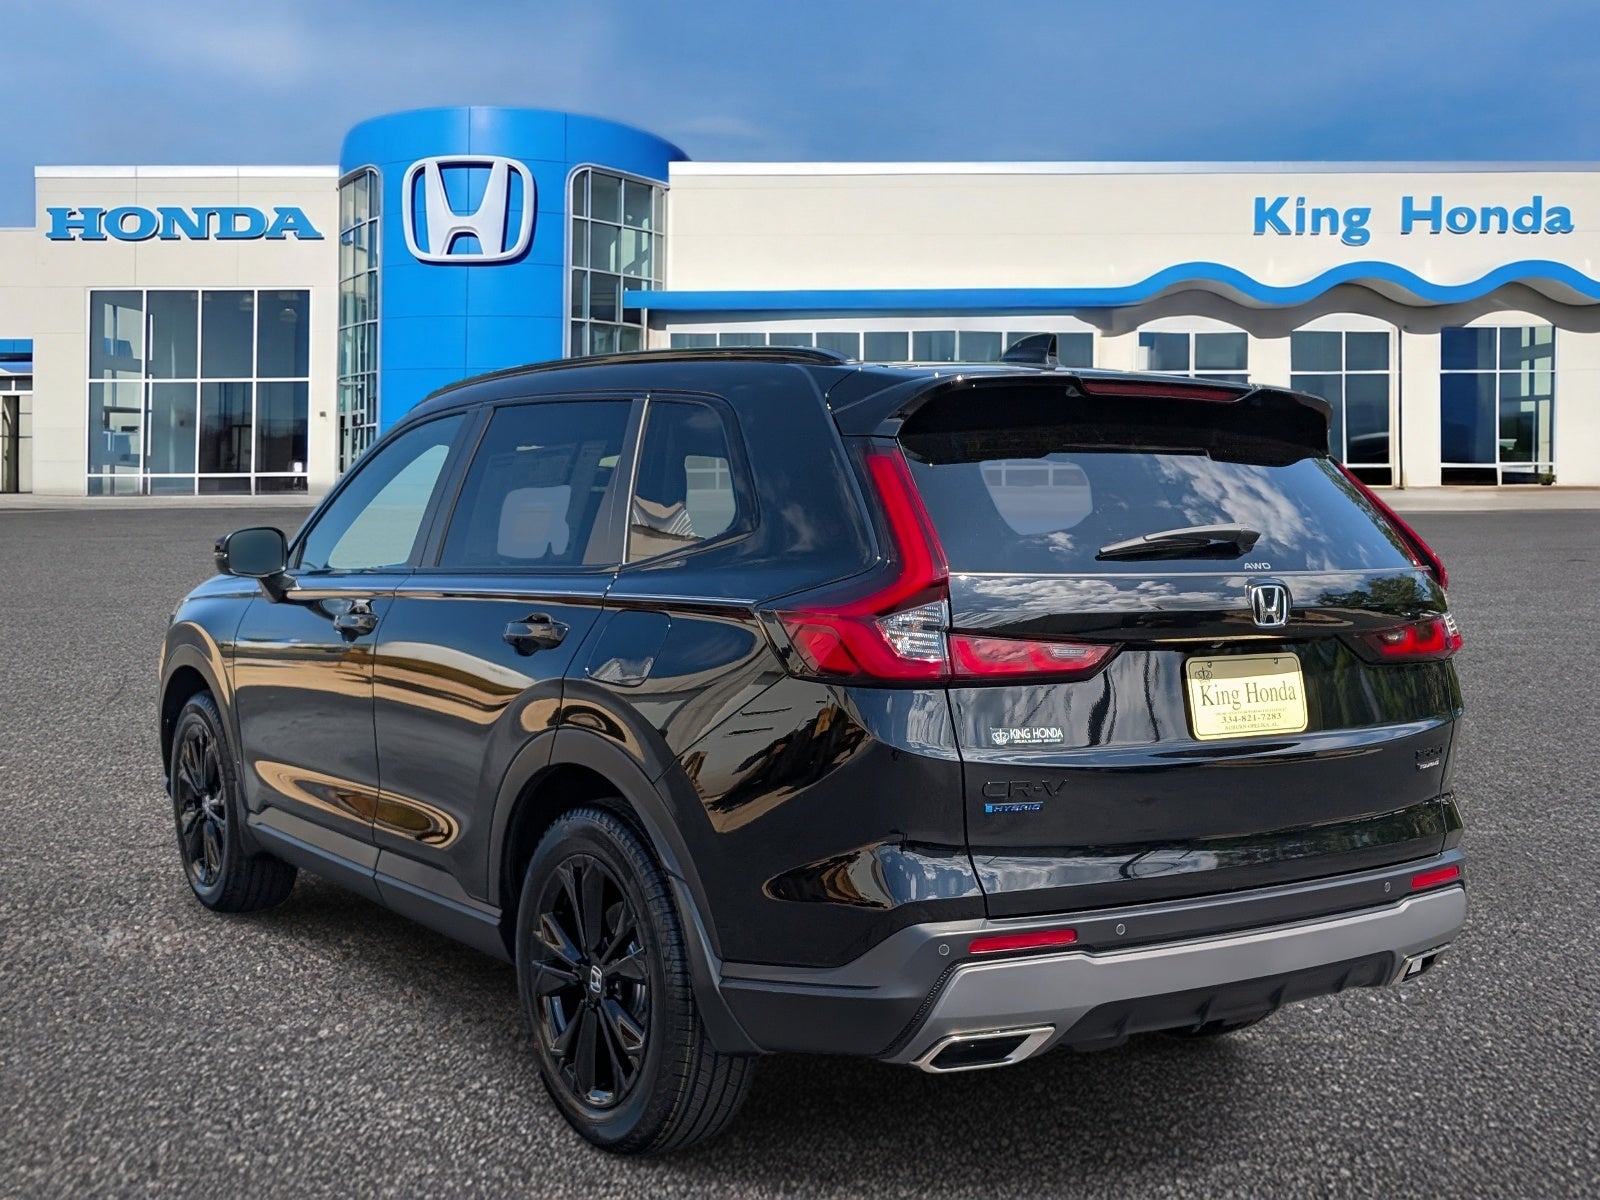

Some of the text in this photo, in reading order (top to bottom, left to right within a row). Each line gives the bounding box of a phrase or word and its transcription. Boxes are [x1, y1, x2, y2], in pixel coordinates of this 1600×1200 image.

[46, 205, 324, 241] HONDA
[1253, 195, 1575, 247] King Honda
[1243, 562, 1271, 570] AWD
[1200, 680, 1297, 710] King Honda
[1221, 712, 1282, 724] 334-821-7283
[1009, 727, 1063, 739] KING HONDA
[982, 778, 1069, 798] CR-V
[993, 803, 1041, 812] HYBRID
